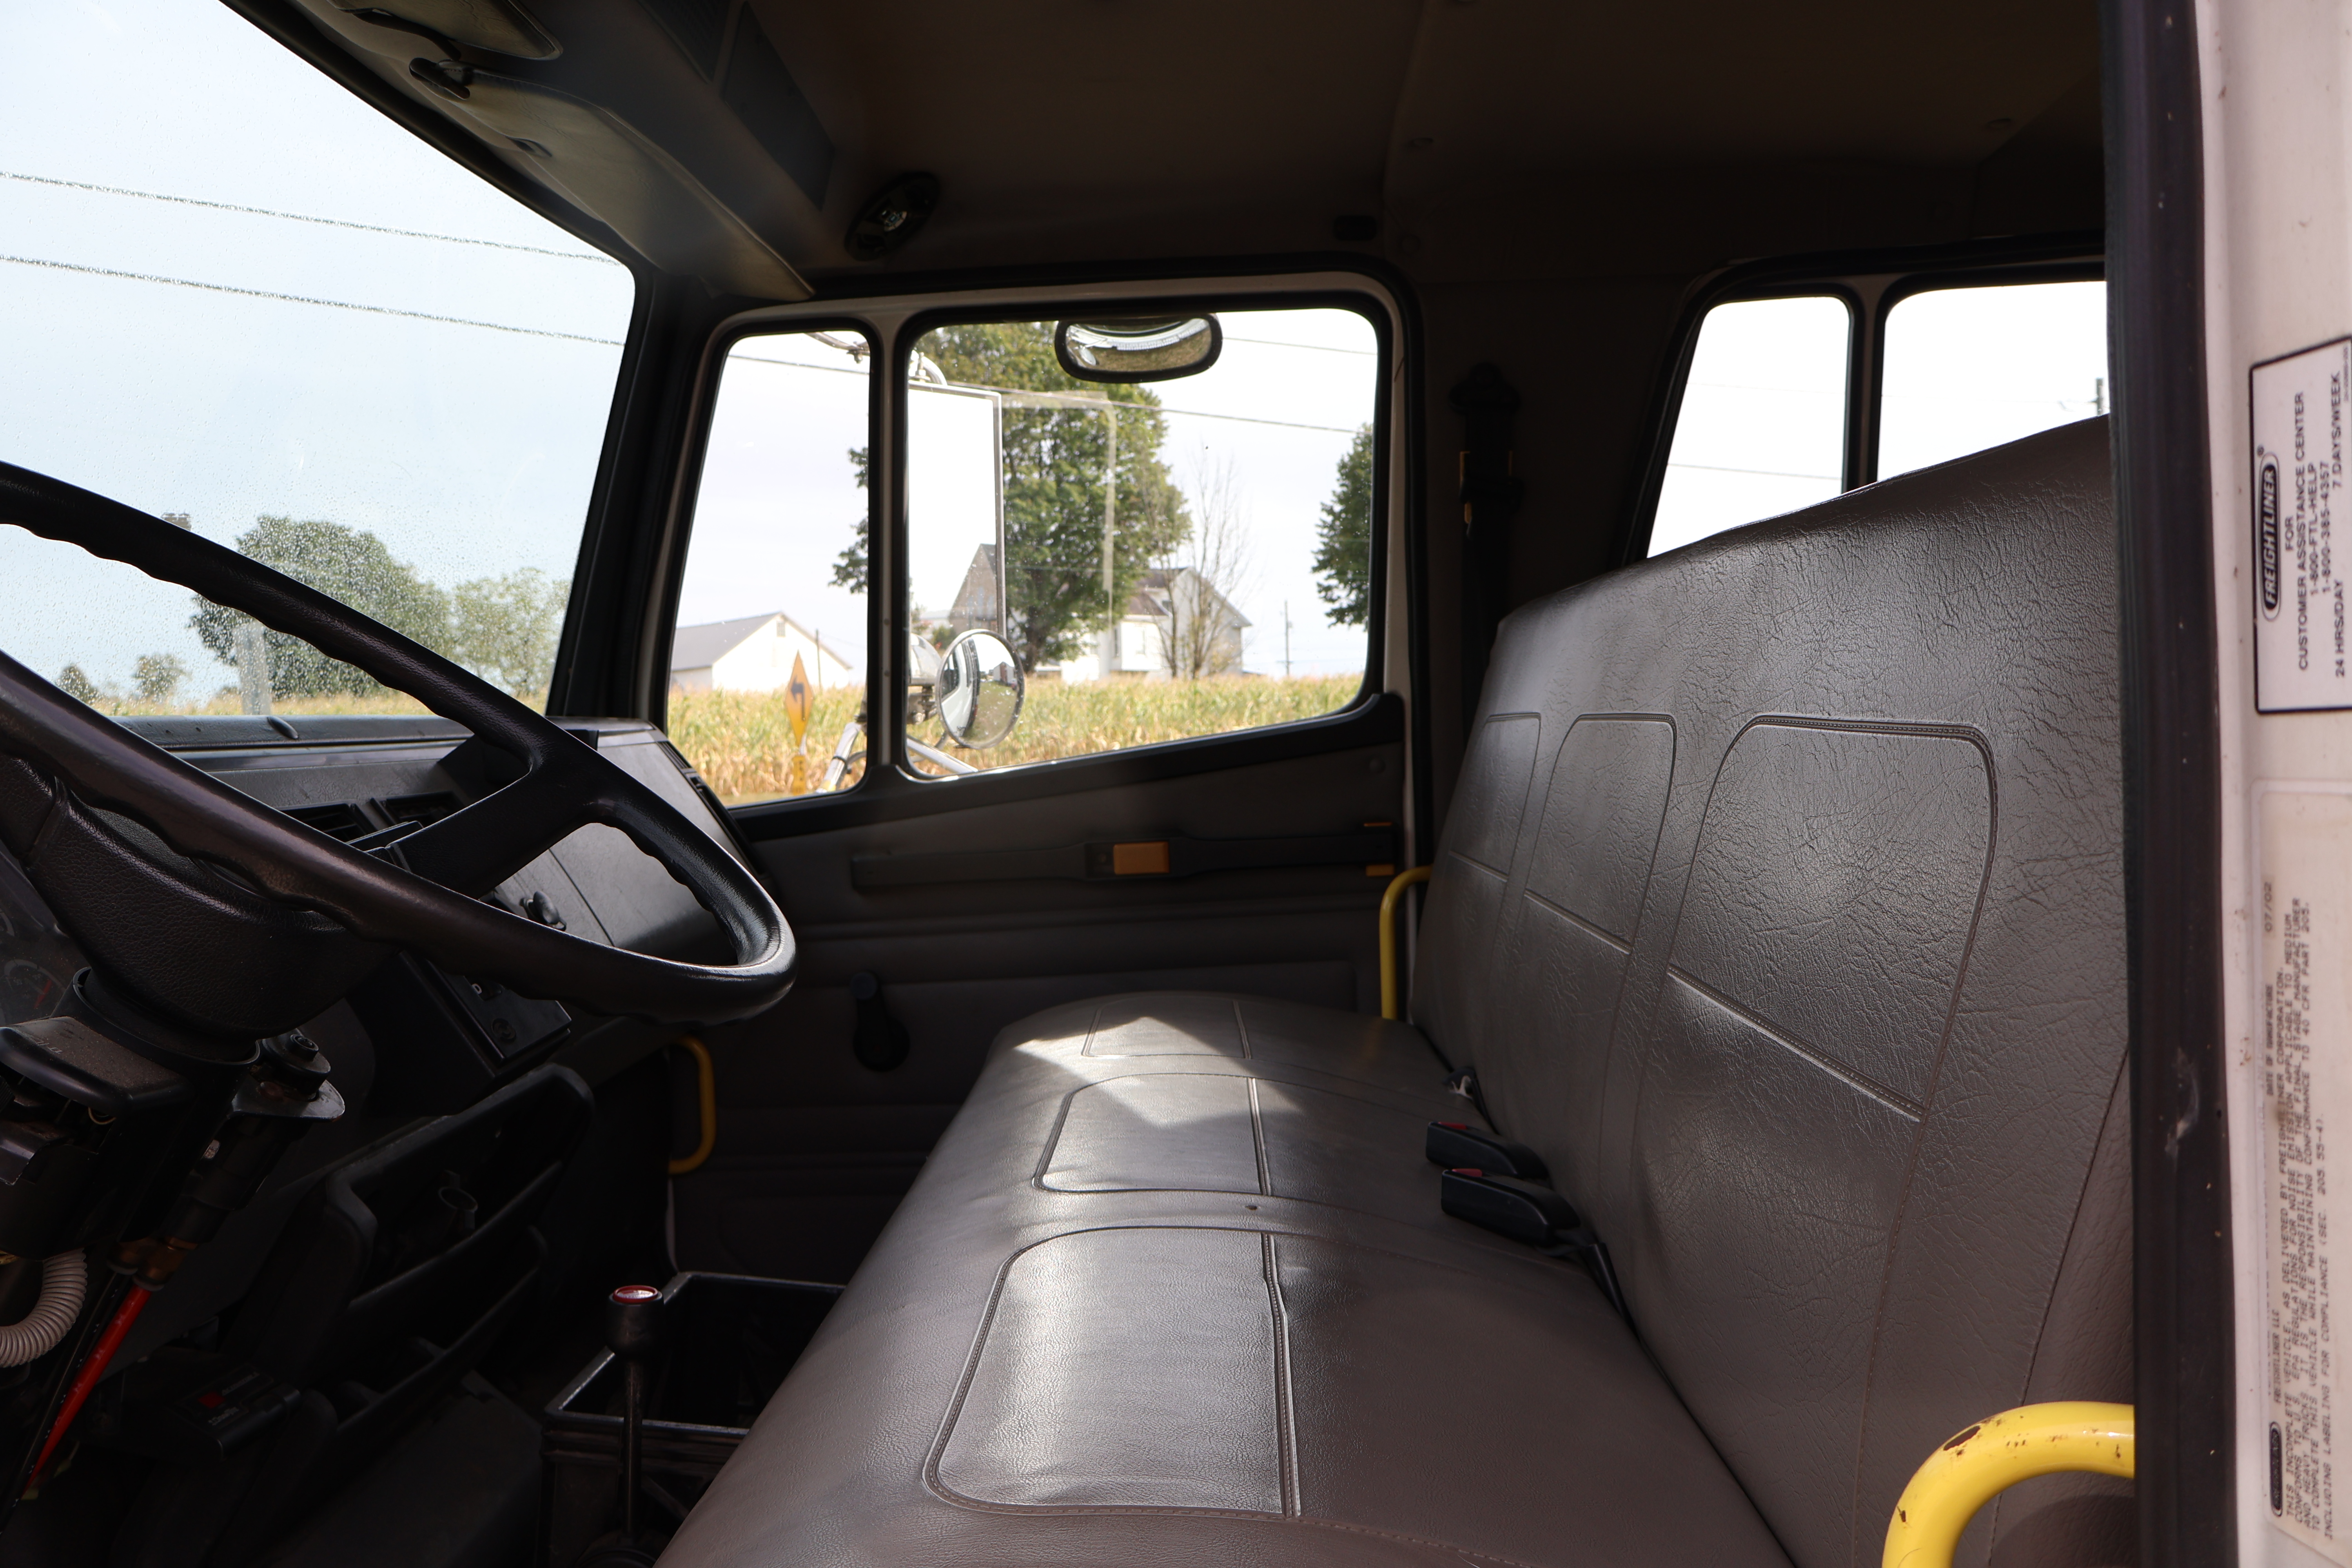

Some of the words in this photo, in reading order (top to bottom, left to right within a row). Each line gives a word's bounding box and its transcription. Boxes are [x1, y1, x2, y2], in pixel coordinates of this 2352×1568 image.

[2294, 392, 2305, 461] CENTER
[2330, 370, 2341, 474] DAYS/WEEK
[2333, 479, 2342, 489] 7
[2262, 468, 2276, 604] FREIGHTLINER
[2285, 516, 2294, 551] FOR
[2296, 465, 2306, 570] ASSISTANCE
[2308, 463, 2318, 595] 1-800-FTL-HELP
[2319, 461, 2331, 593] 1-800-385-4357
[2298, 575, 2308, 670] CUSTOMER
[2334, 579, 2344, 653] HRS/DAY
[2335, 659, 2345, 677] 24
[2264, 881, 2272, 932] 07/02
[2285, 973, 2292, 988] TO
[2292, 898, 2300, 1000] MANUFACTURER
[2265, 984, 2273, 1048] MANUFACTURE
[2302, 1018, 2310, 1036] 40
[2266, 1054, 2273, 1066] OF
[2302, 1044, 2310, 1061] TO
[2302, 1071, 2312, 1165] CONFORMANCE
[2295, 1145, 2303, 1162] OF
[2280, 1182, 2287, 1199] BY
[2288, 1168, 2296, 1210] NOISE
[2305, 1173, 2314, 1268] MAINTAINING
[2296, 1170, 2307, 1290] RESPONSIBILITY
[2282, 1291, 2290, 1308] AS
[2290, 1252, 2299, 1345] REGULATIONS
[2319, 1255, 2329, 1342] COMPLIANCE
[2272, 1332, 2281, 1403] FREIGHTLINER
[2300, 1331, 2308, 1348] IS
[2300, 1357, 2308, 1374] IT
[2308, 1327, 2317, 1387] VEHICLE
[2321, 1349, 2330, 1376] FOR
[2284, 1392, 2294, 1474] INCOMPLETE
[2294, 1429, 2301, 1445] TO
[2309, 1395, 2318, 1428] THIS
[2321, 1384, 2331, 1455] LABELING
[2294, 1454, 2302, 1523] CONFORMS
[2311, 1438, 2319, 1508] COMPLETE
[2323, 1461, 2333, 1540] INCLUDING
[2312, 1514, 2320, 1530] TO
